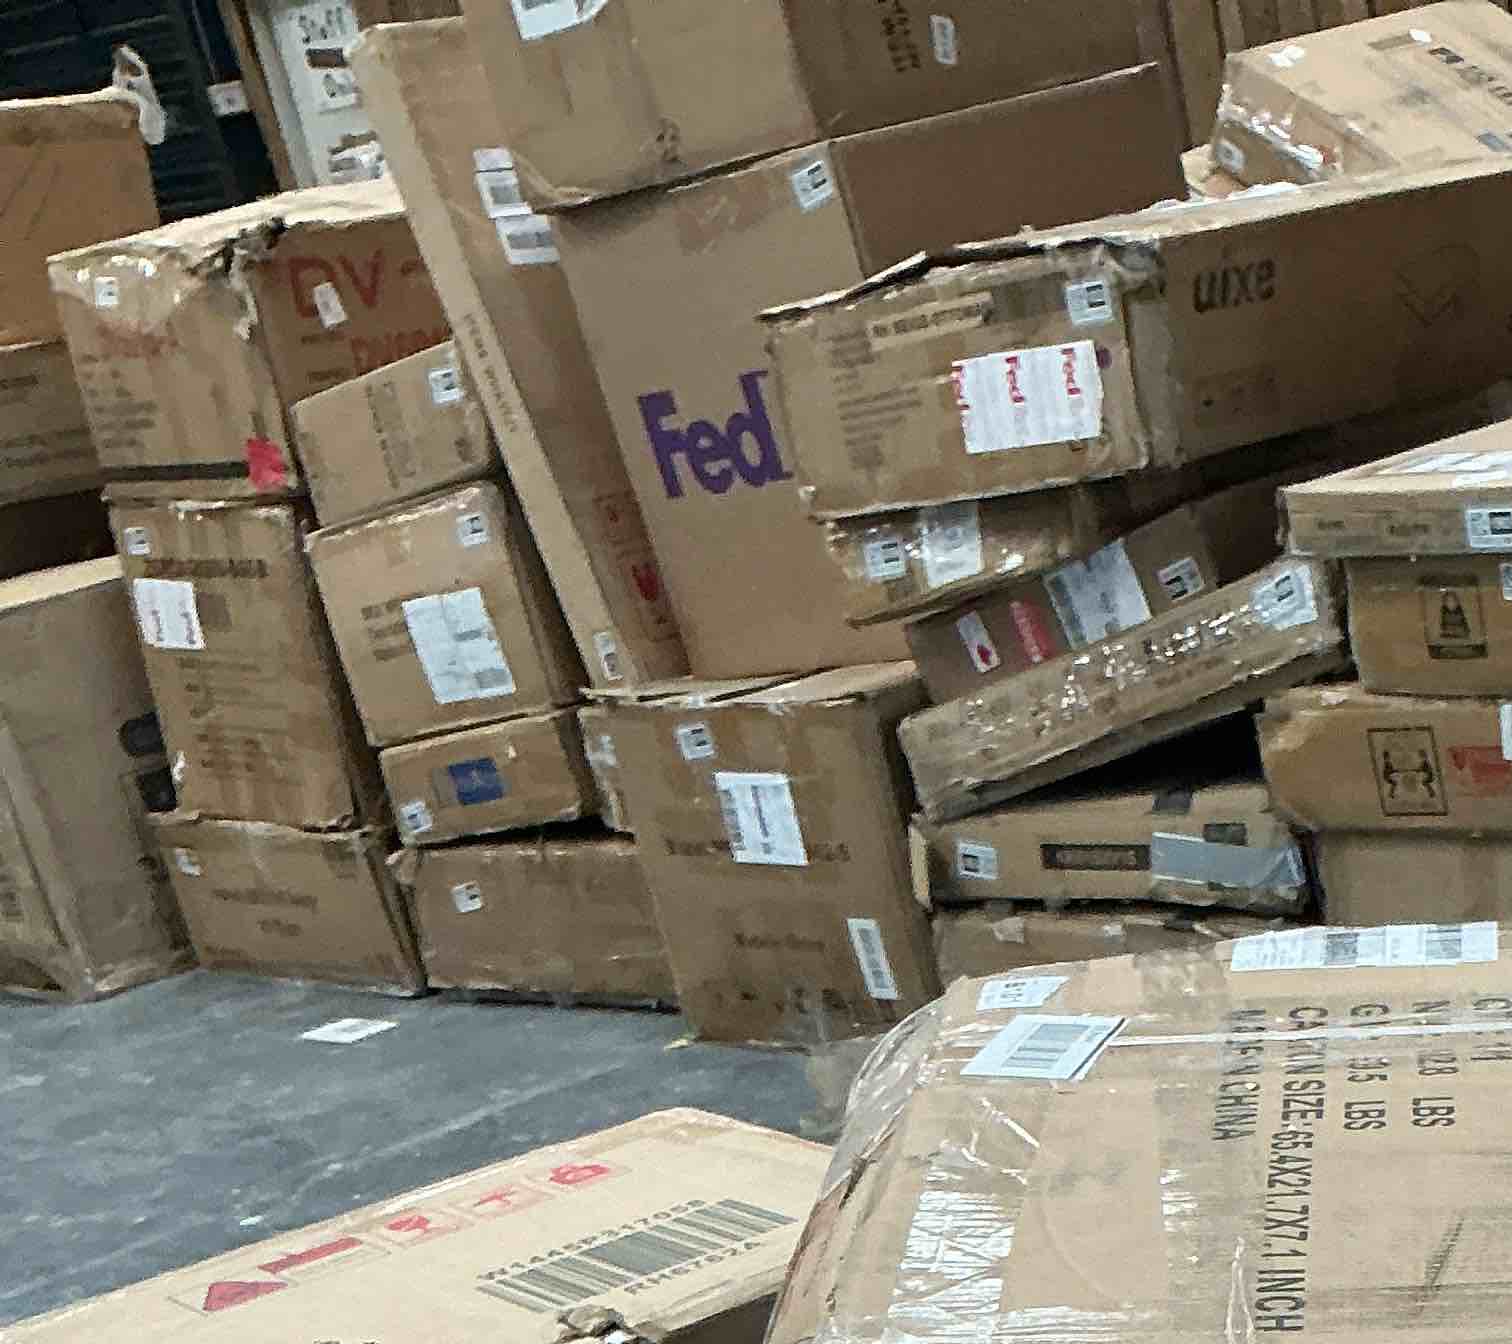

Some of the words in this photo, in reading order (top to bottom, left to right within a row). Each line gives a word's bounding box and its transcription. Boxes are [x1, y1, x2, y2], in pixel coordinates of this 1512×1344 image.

[637, 370, 793, 498] Fed
[1211, 1080, 1261, 1141] CHINA
[1344, 1100, 1387, 1131] LBS
[1412, 1096, 1456, 1128] LBS
[1255, 1269, 1306, 1332] INCH
